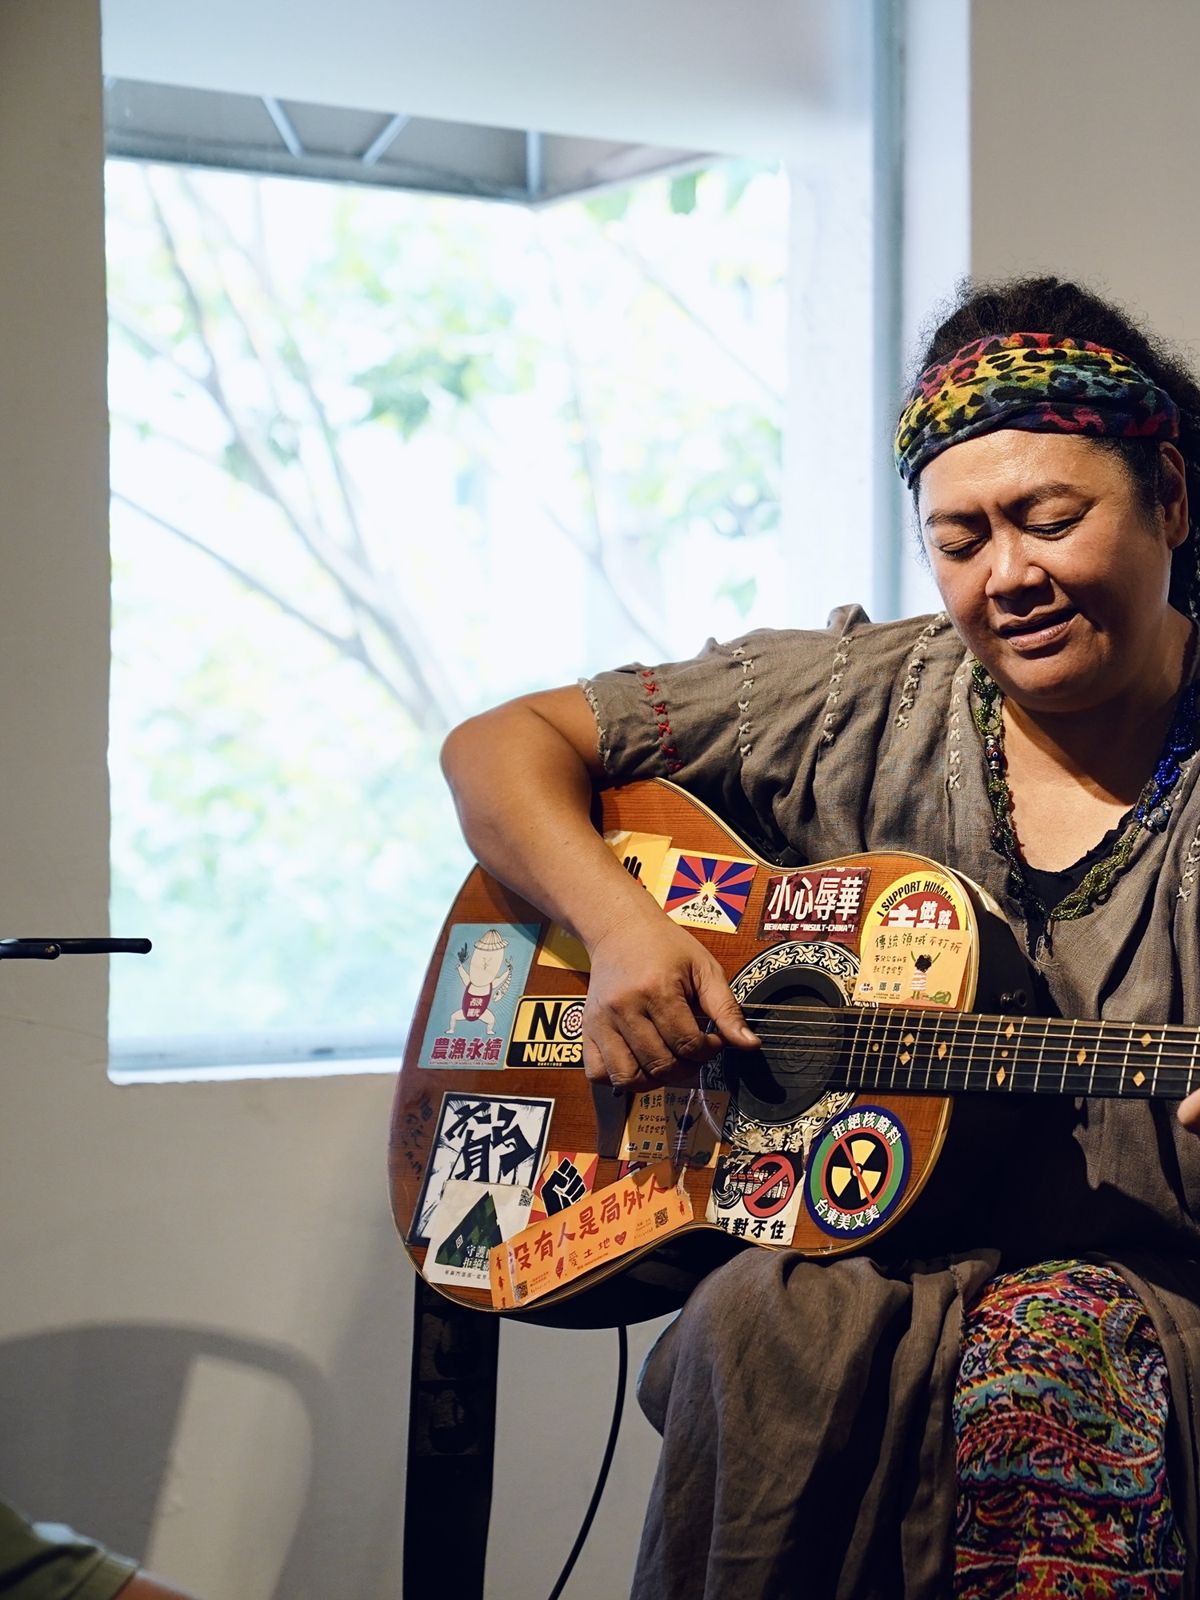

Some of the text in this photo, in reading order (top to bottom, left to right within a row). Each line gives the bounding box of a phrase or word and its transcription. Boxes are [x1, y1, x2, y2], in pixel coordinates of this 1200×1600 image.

[767, 876, 863, 921] 小心辱華
[881, 880, 922, 912] SUPPORT
[763, 923, 790, 932] BEWARE
[790, 923, 799, 932] OF
[527, 1001, 586, 1041] NO
[430, 1037, 504, 1061] 農漁永續
[522, 1043, 583, 1063] NUKES
[831, 1111, 902, 1146] 拒絕核廢料
[508, 1173, 668, 1271] 沒有人是局外人
[814, 1197, 880, 1231] 台東美又美
